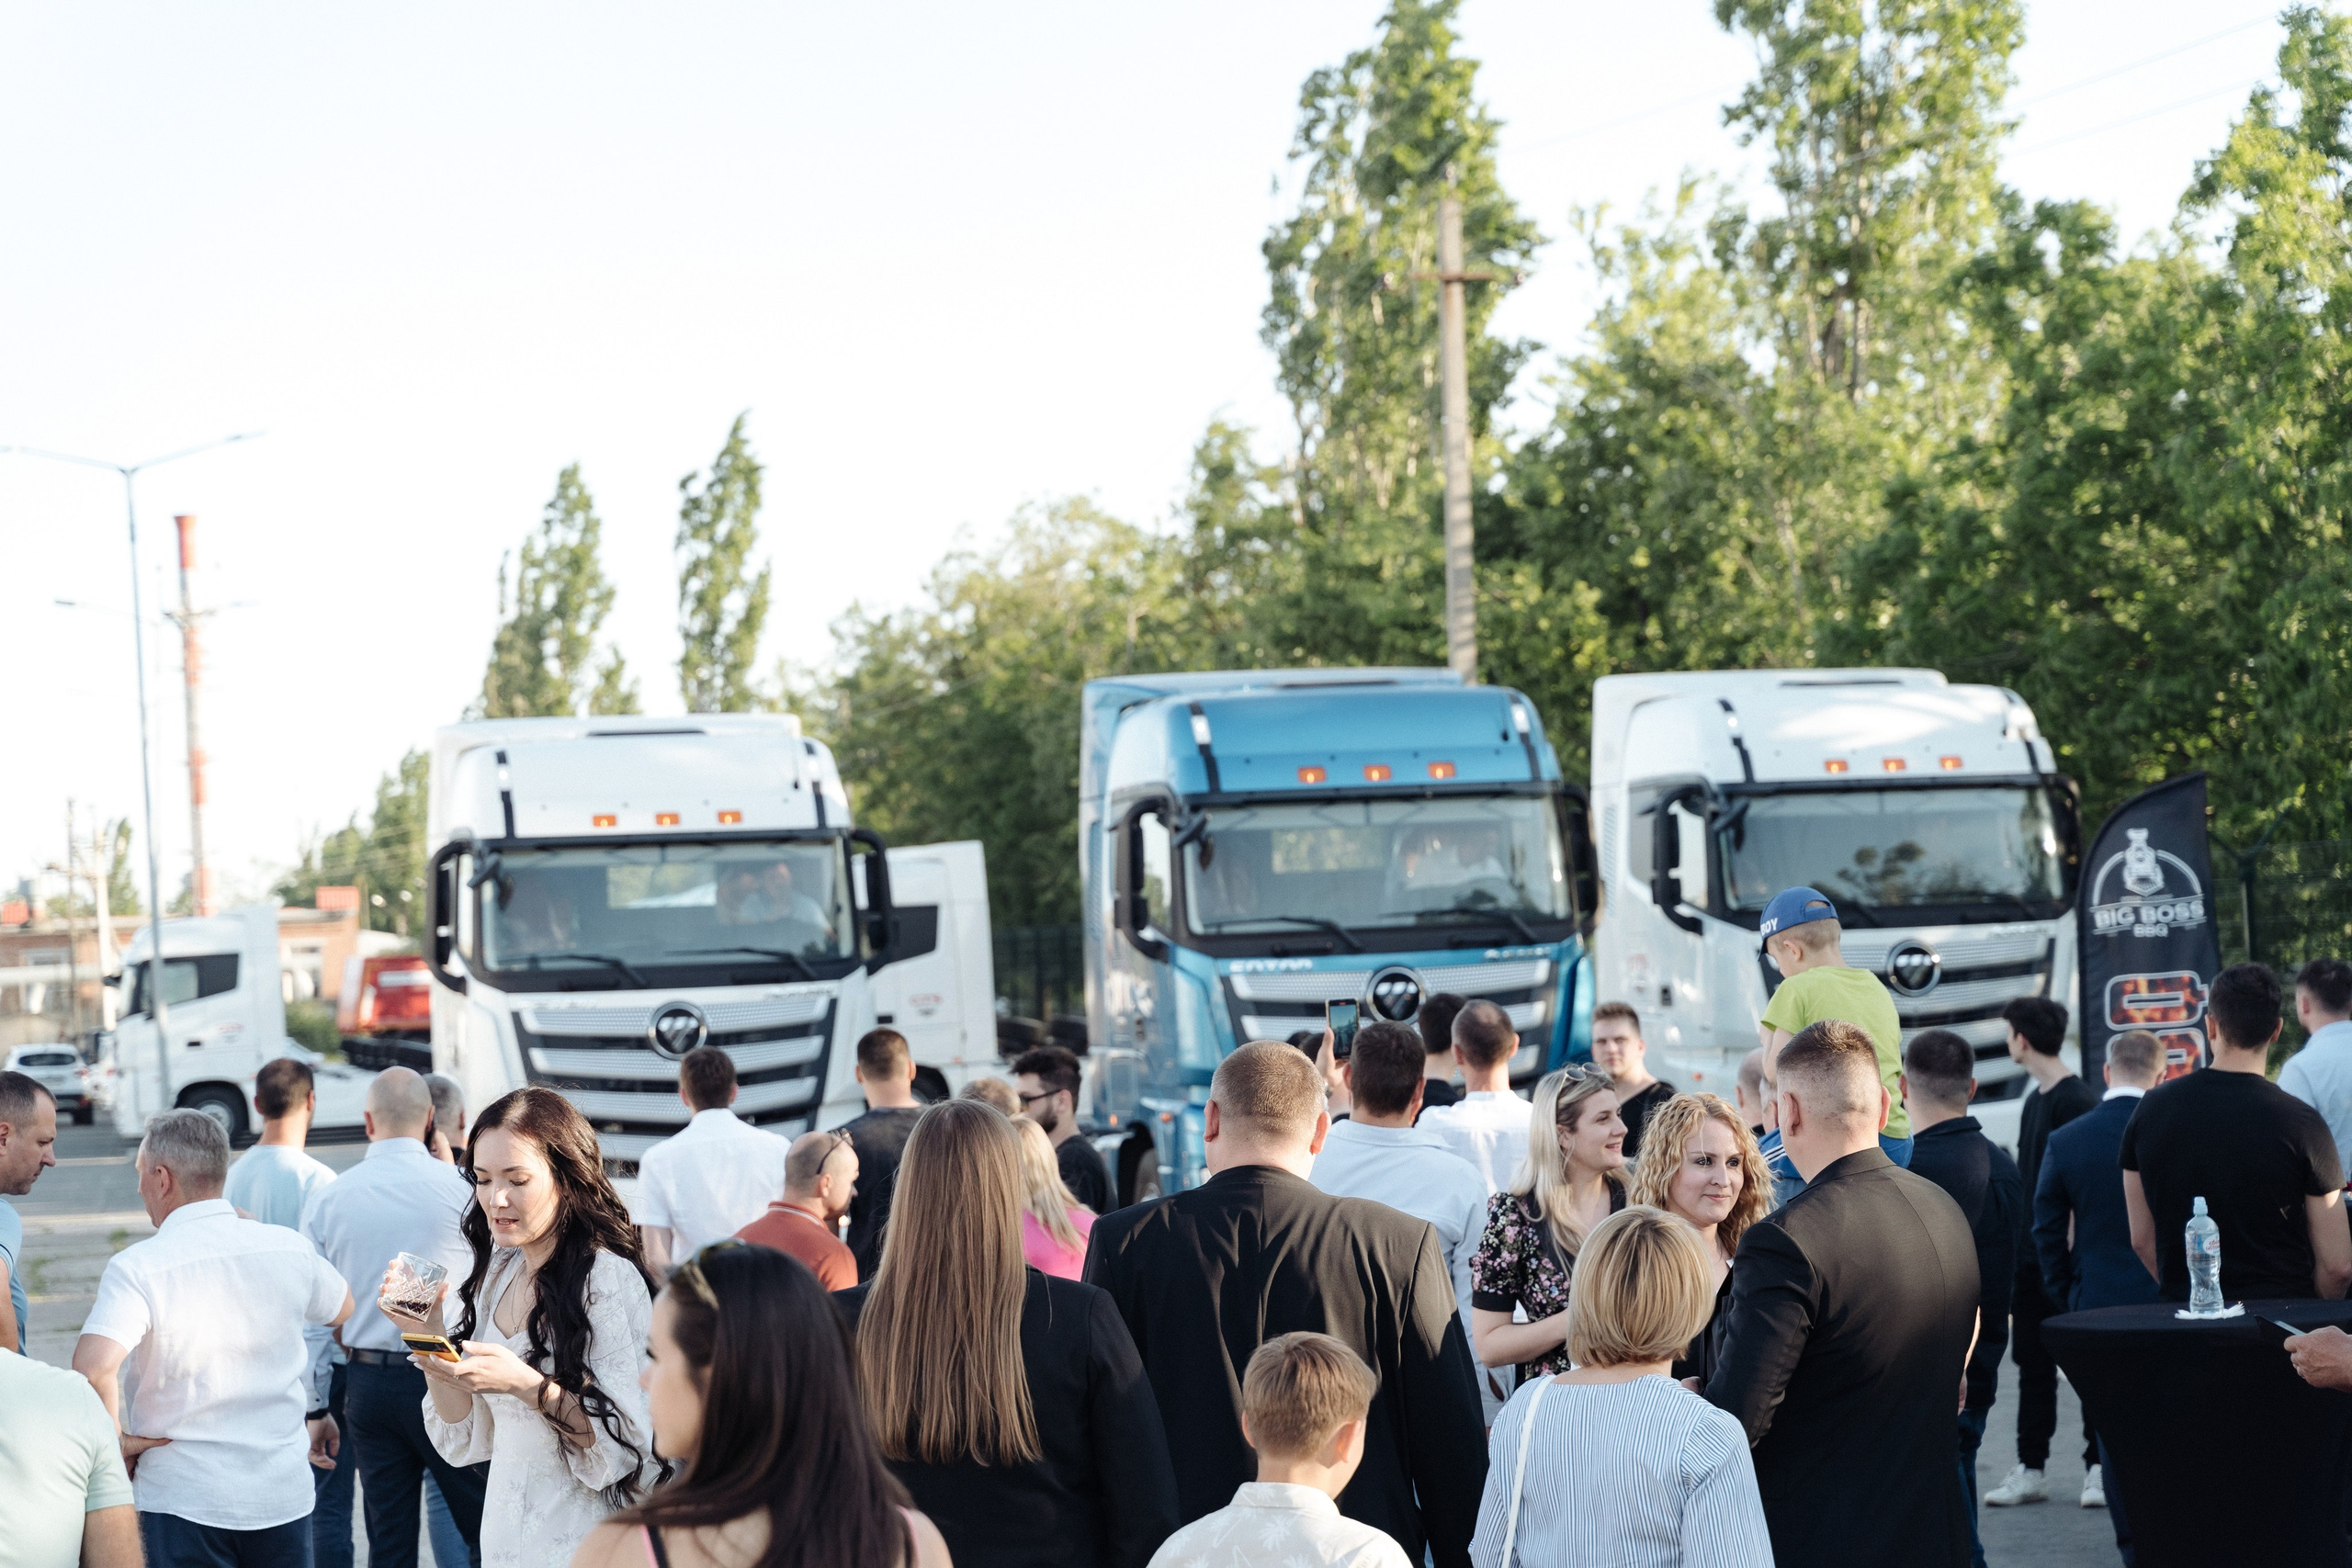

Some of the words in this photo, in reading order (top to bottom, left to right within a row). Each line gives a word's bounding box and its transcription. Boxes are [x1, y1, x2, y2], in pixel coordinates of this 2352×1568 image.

[2095, 906, 2135, 929] BIG
[2140, 900, 2204, 924] BOSS
[2133, 923, 2168, 937] BBQ
